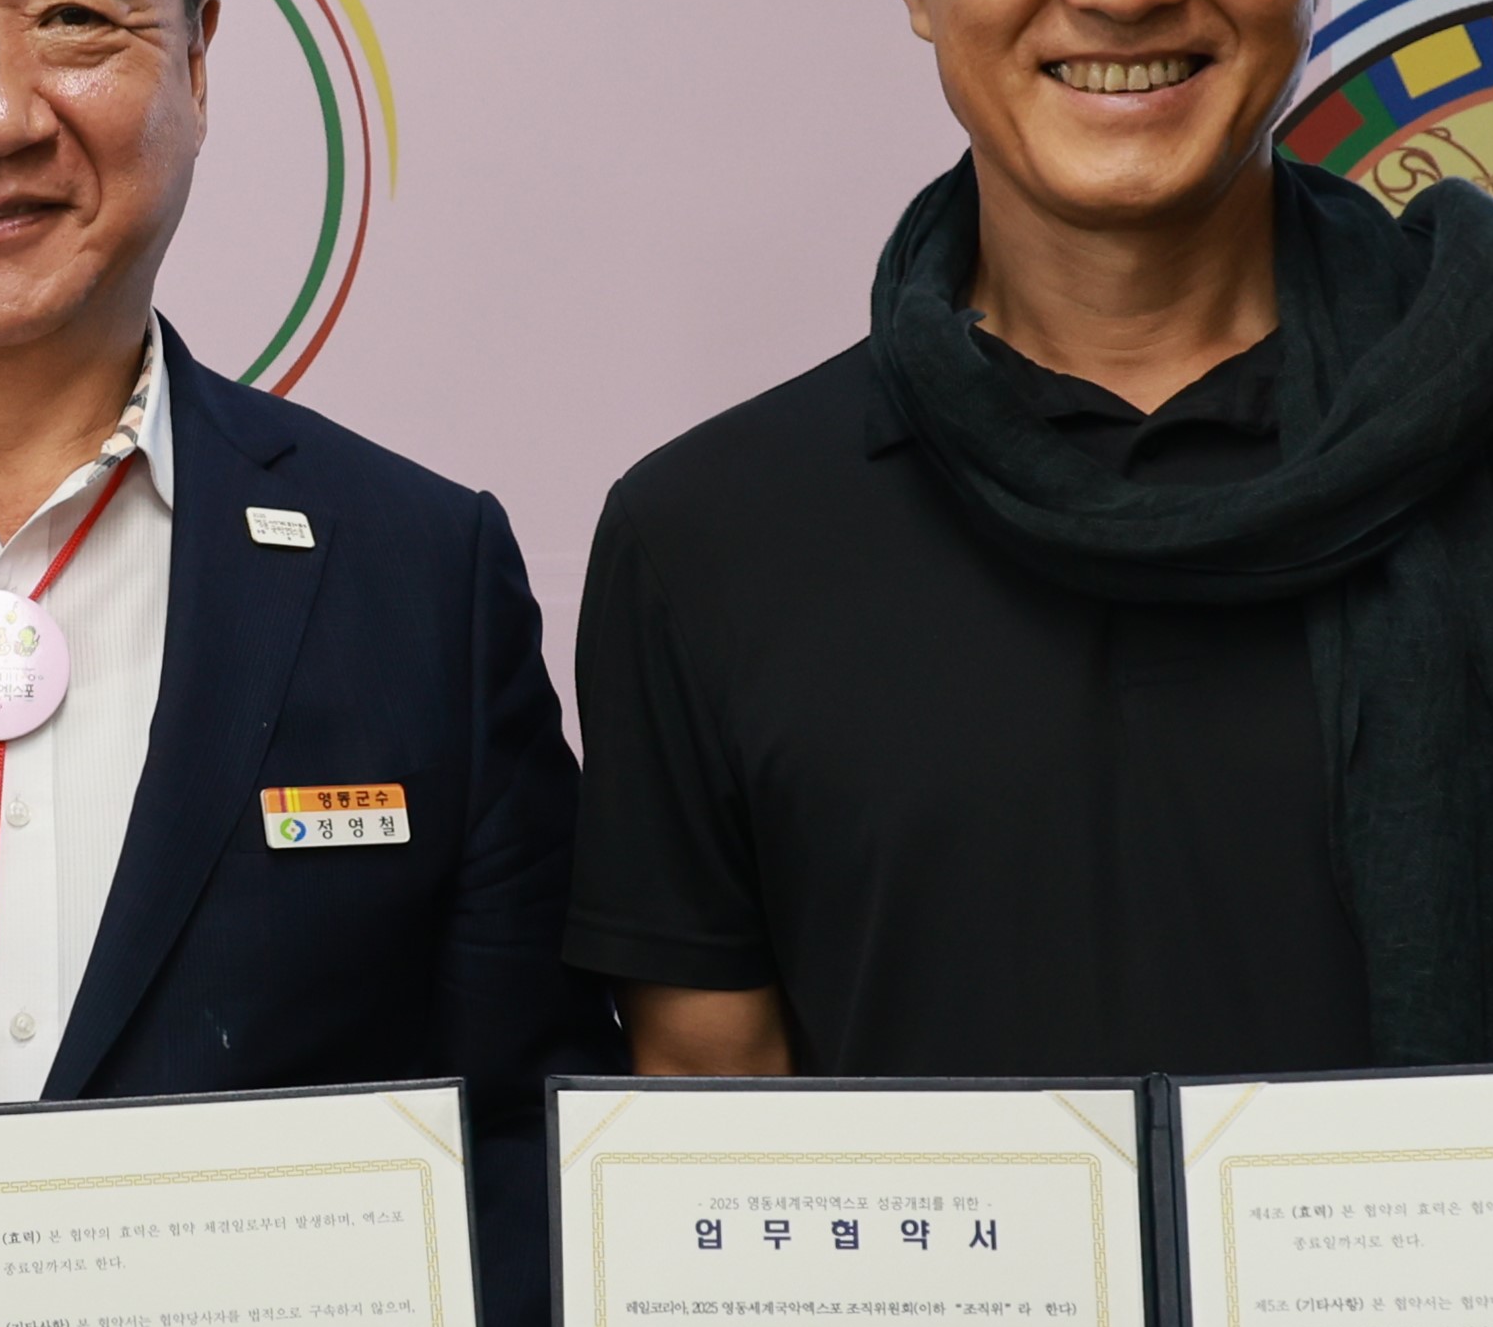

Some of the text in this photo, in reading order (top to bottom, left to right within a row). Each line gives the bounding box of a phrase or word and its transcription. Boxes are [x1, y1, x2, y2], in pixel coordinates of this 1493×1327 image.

[318, 791, 388, 809] 영동군수
[710, 1198, 739, 1210] 2025
[878, 1196, 944, 1211] 성공개최를
[953, 1197, 979, 1211] 위한
